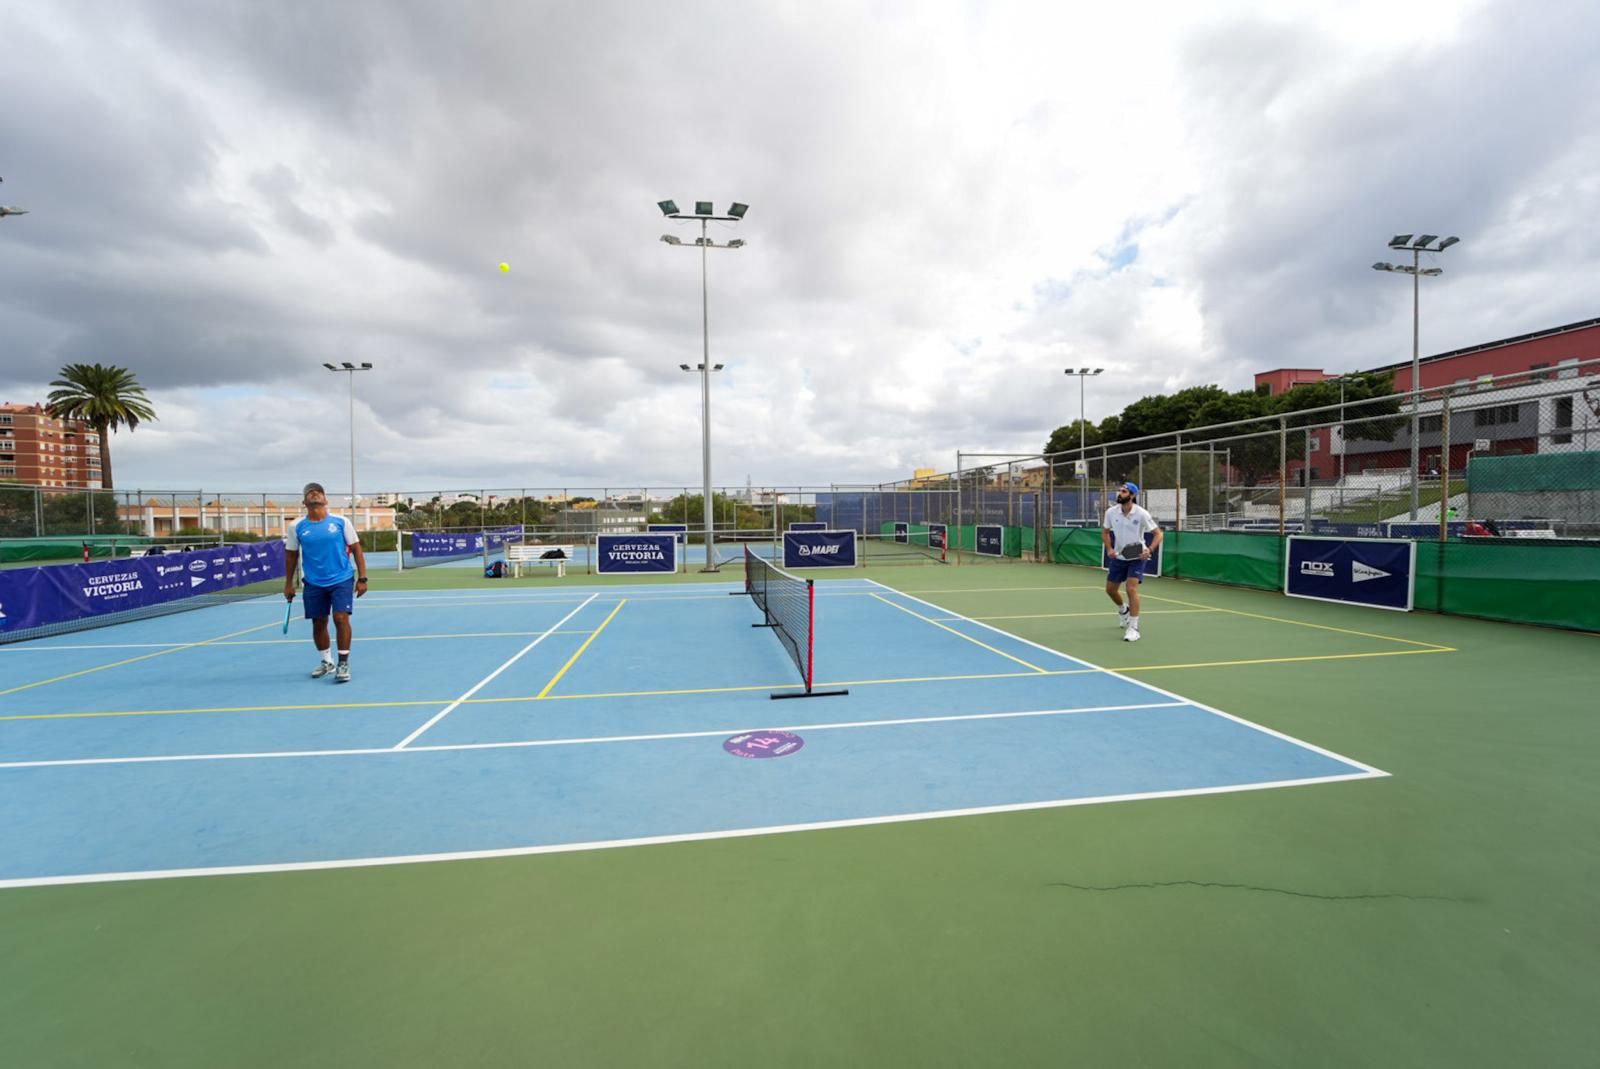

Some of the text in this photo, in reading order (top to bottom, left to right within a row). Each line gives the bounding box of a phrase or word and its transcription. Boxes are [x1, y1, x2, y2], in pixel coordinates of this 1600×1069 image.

[608, 551, 664, 560] VICTORIA
[811, 545, 840, 555] MAPEI
[88, 571, 138, 586] CERVEZAS
[83, 580, 143, 598] VICTORIA
[746, 738, 780, 749] 14
